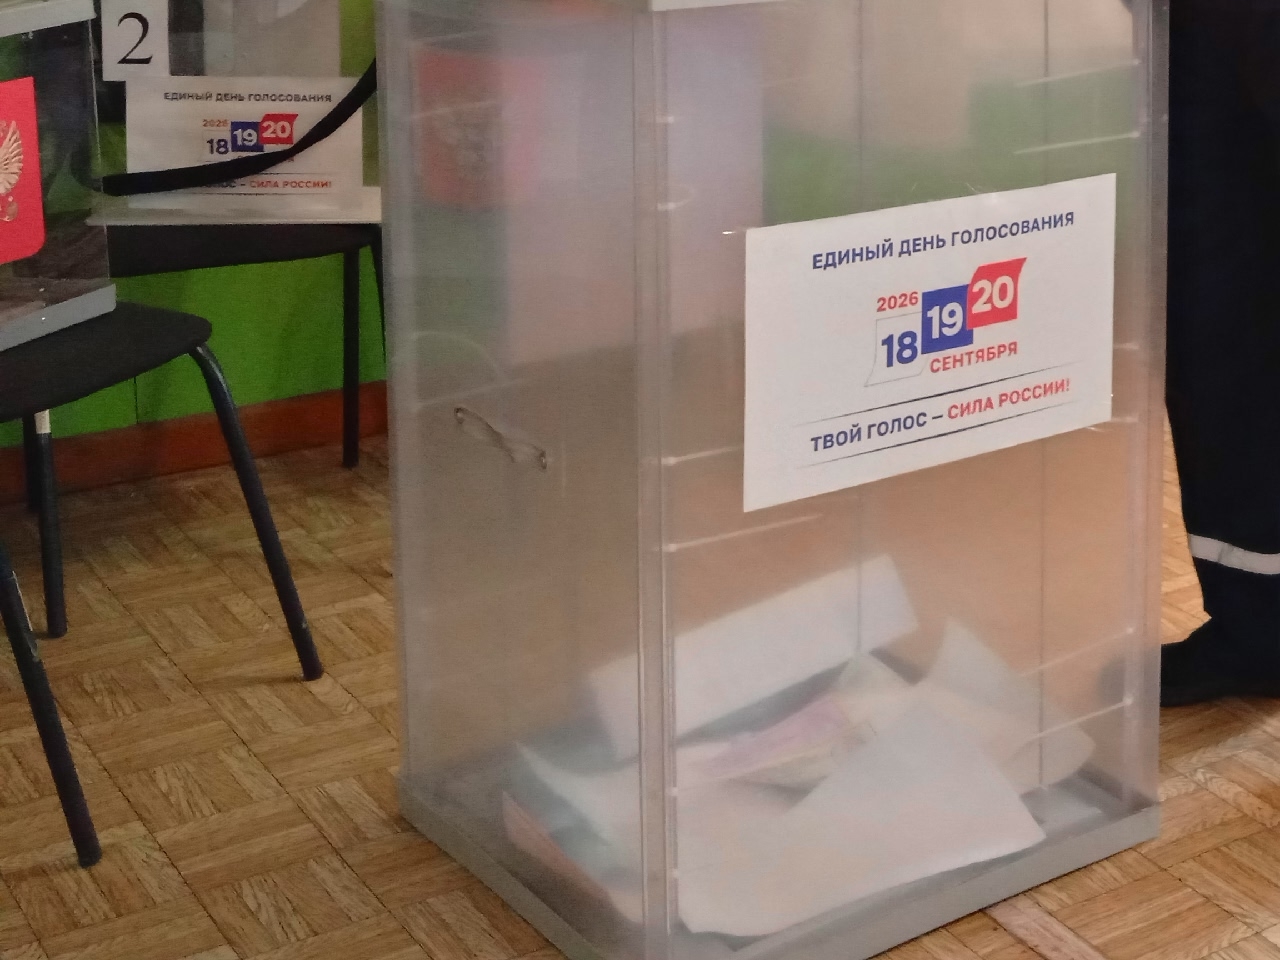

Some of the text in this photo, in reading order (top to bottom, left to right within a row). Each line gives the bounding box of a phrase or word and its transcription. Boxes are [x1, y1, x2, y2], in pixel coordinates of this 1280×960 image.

[117, 12, 153, 65] 2
[164, 92, 332, 103] ЕДИНЫЙ ДЕНЬ ГОЛОСОВАНИЯ
[206, 121, 292, 155] 18 19 20
[250, 181, 279, 189] СИЛА
[812, 211, 1075, 270] ЕДИНЫЙ ДЕНЬ ГОЛОСОВАНИЯ
[876, 291, 919, 312] 2026
[881, 275, 1015, 368] 18 19 20
[930, 341, 1018, 374] СЕНТЯБРЯ
[810, 424, 862, 451] ТВОЙ
[867, 412, 927, 439] ГОЛОС
[947, 396, 995, 420] СИЛА
[998, 378, 1071, 407] РОССИИ!
